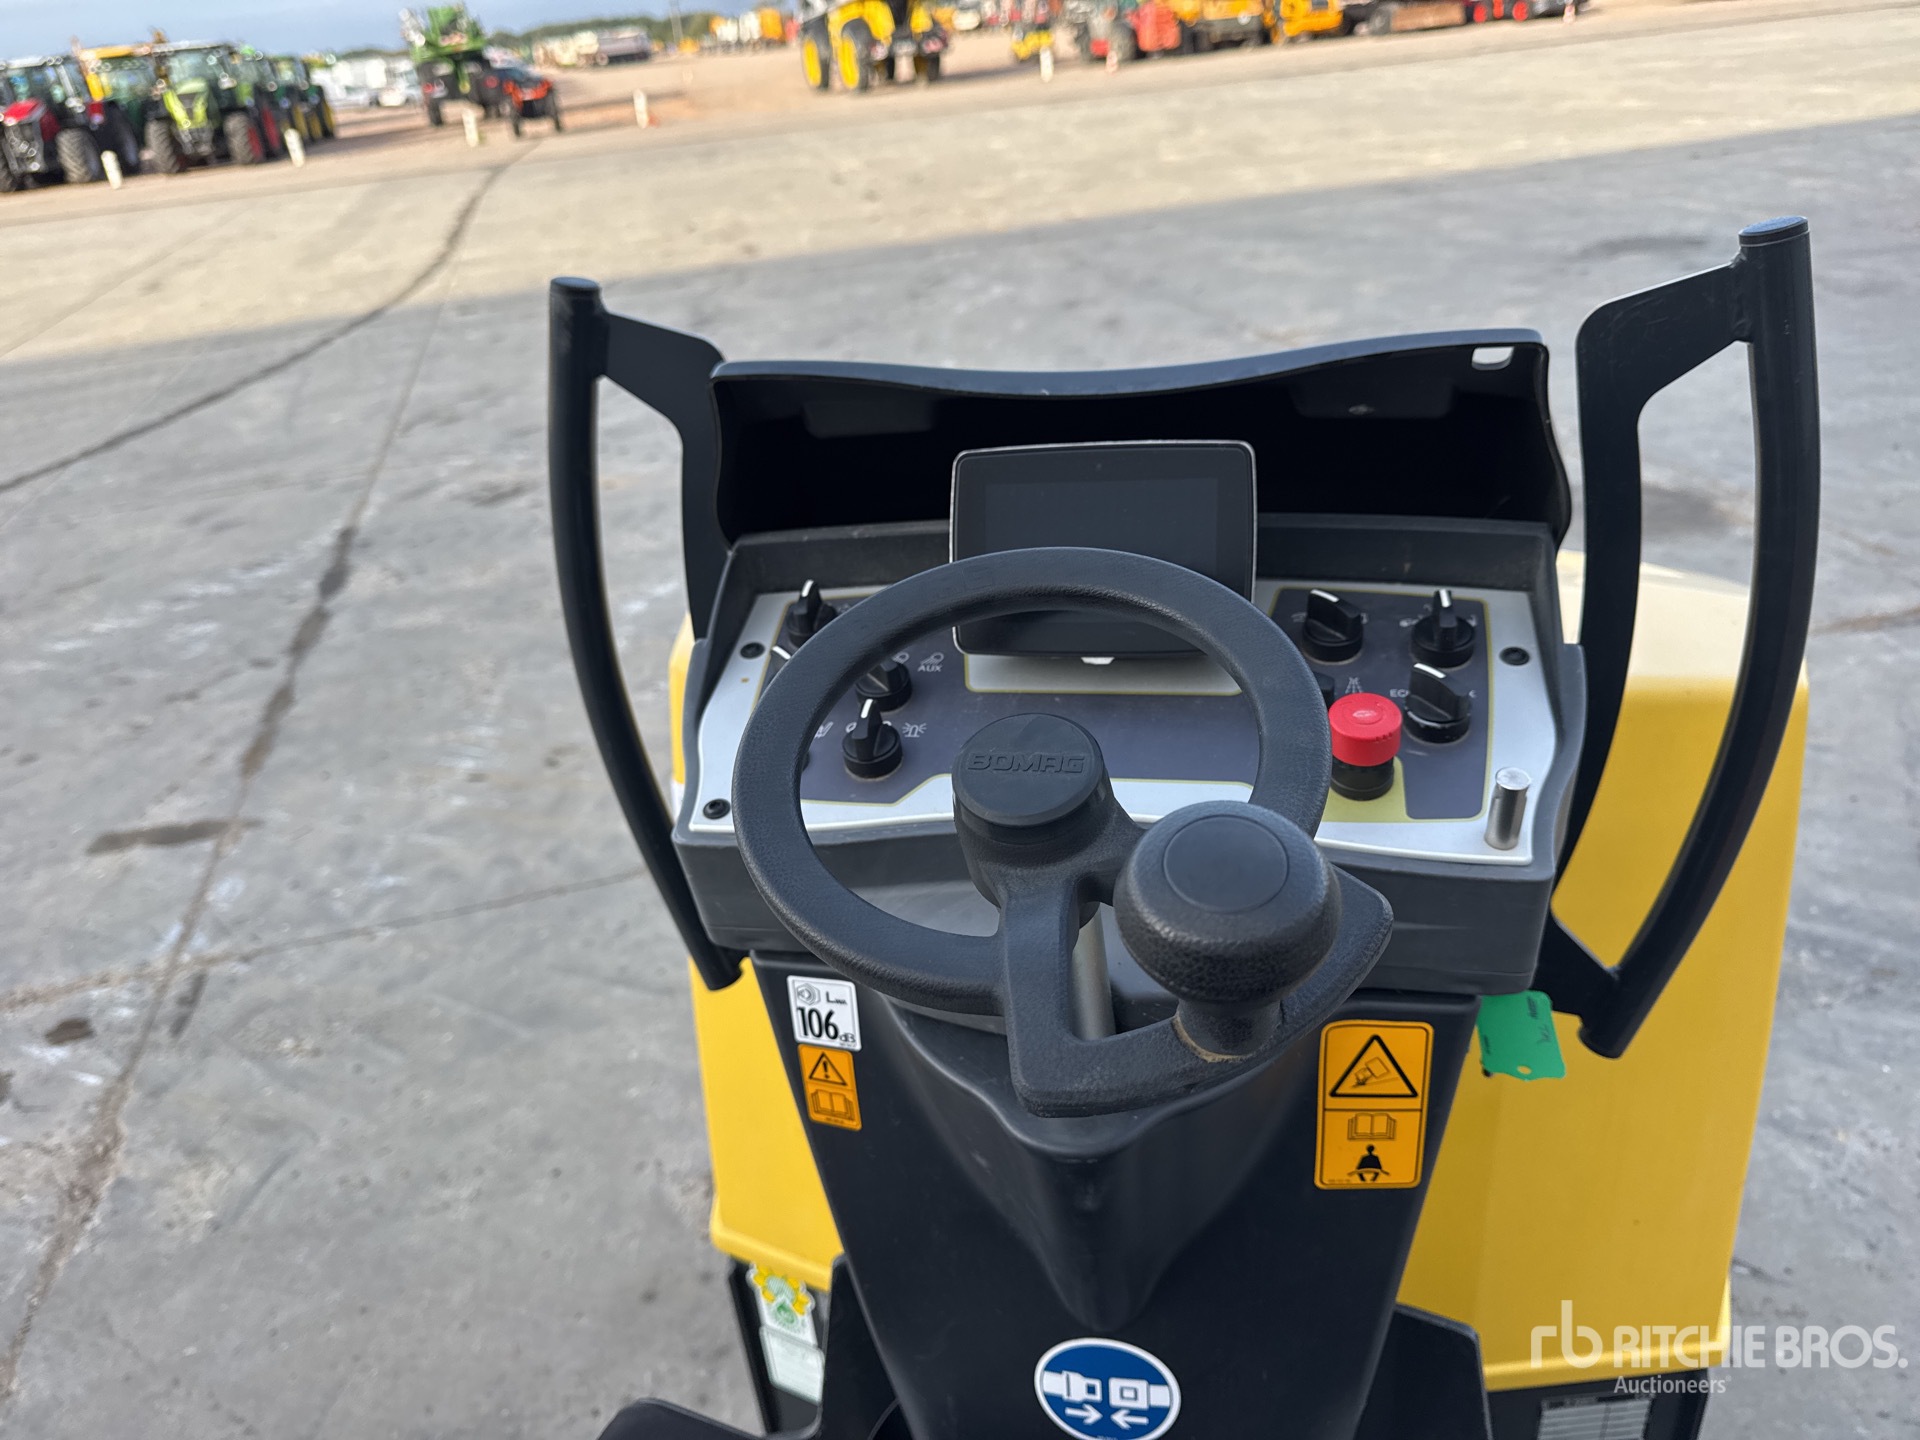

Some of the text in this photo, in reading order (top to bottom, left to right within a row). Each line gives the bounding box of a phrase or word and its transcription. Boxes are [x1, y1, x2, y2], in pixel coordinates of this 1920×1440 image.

[917, 663, 942, 673] AUX
[967, 754, 1085, 773] BOMAG
[797, 1006, 856, 1043] 106 dB
